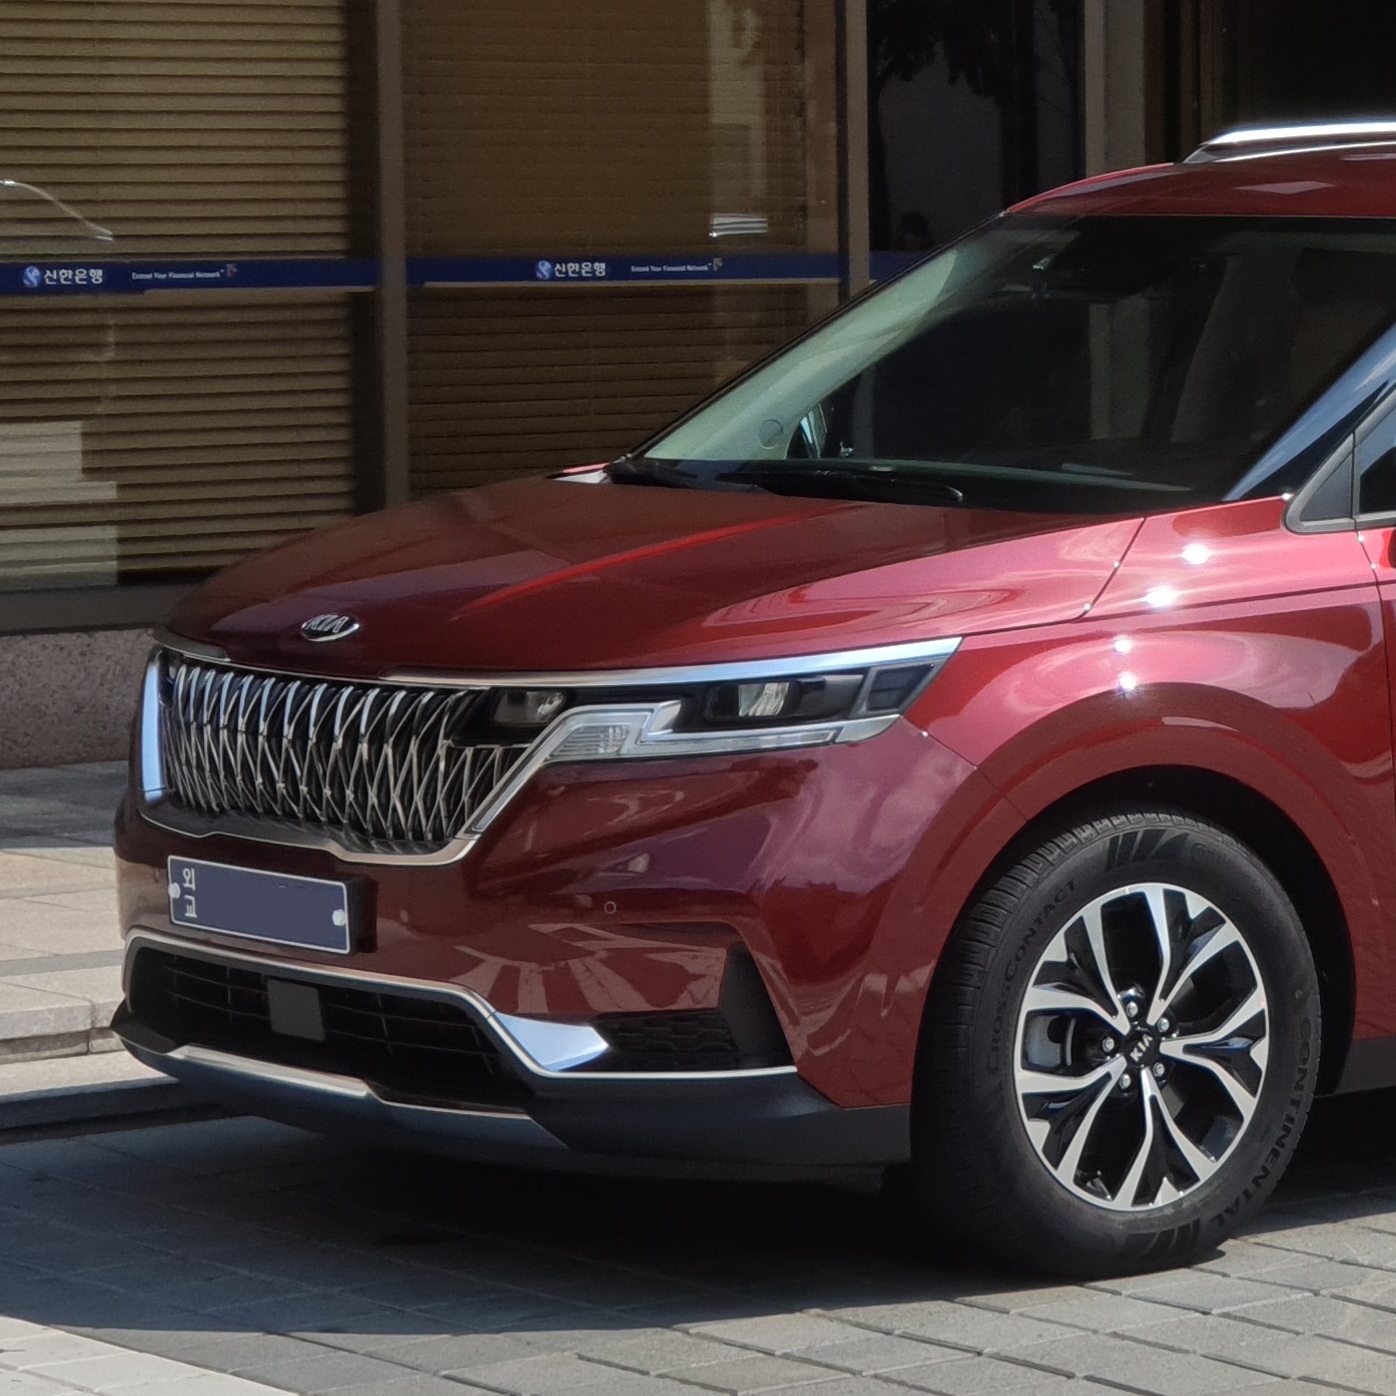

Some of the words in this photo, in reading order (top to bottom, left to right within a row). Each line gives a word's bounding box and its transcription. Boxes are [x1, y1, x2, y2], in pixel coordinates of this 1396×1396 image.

[43, 268, 103, 285] 신한은행
[554, 262, 606, 278] 신한은행
[304, 614, 350, 634] KIA
[1129, 1033, 1154, 1063] KIA
